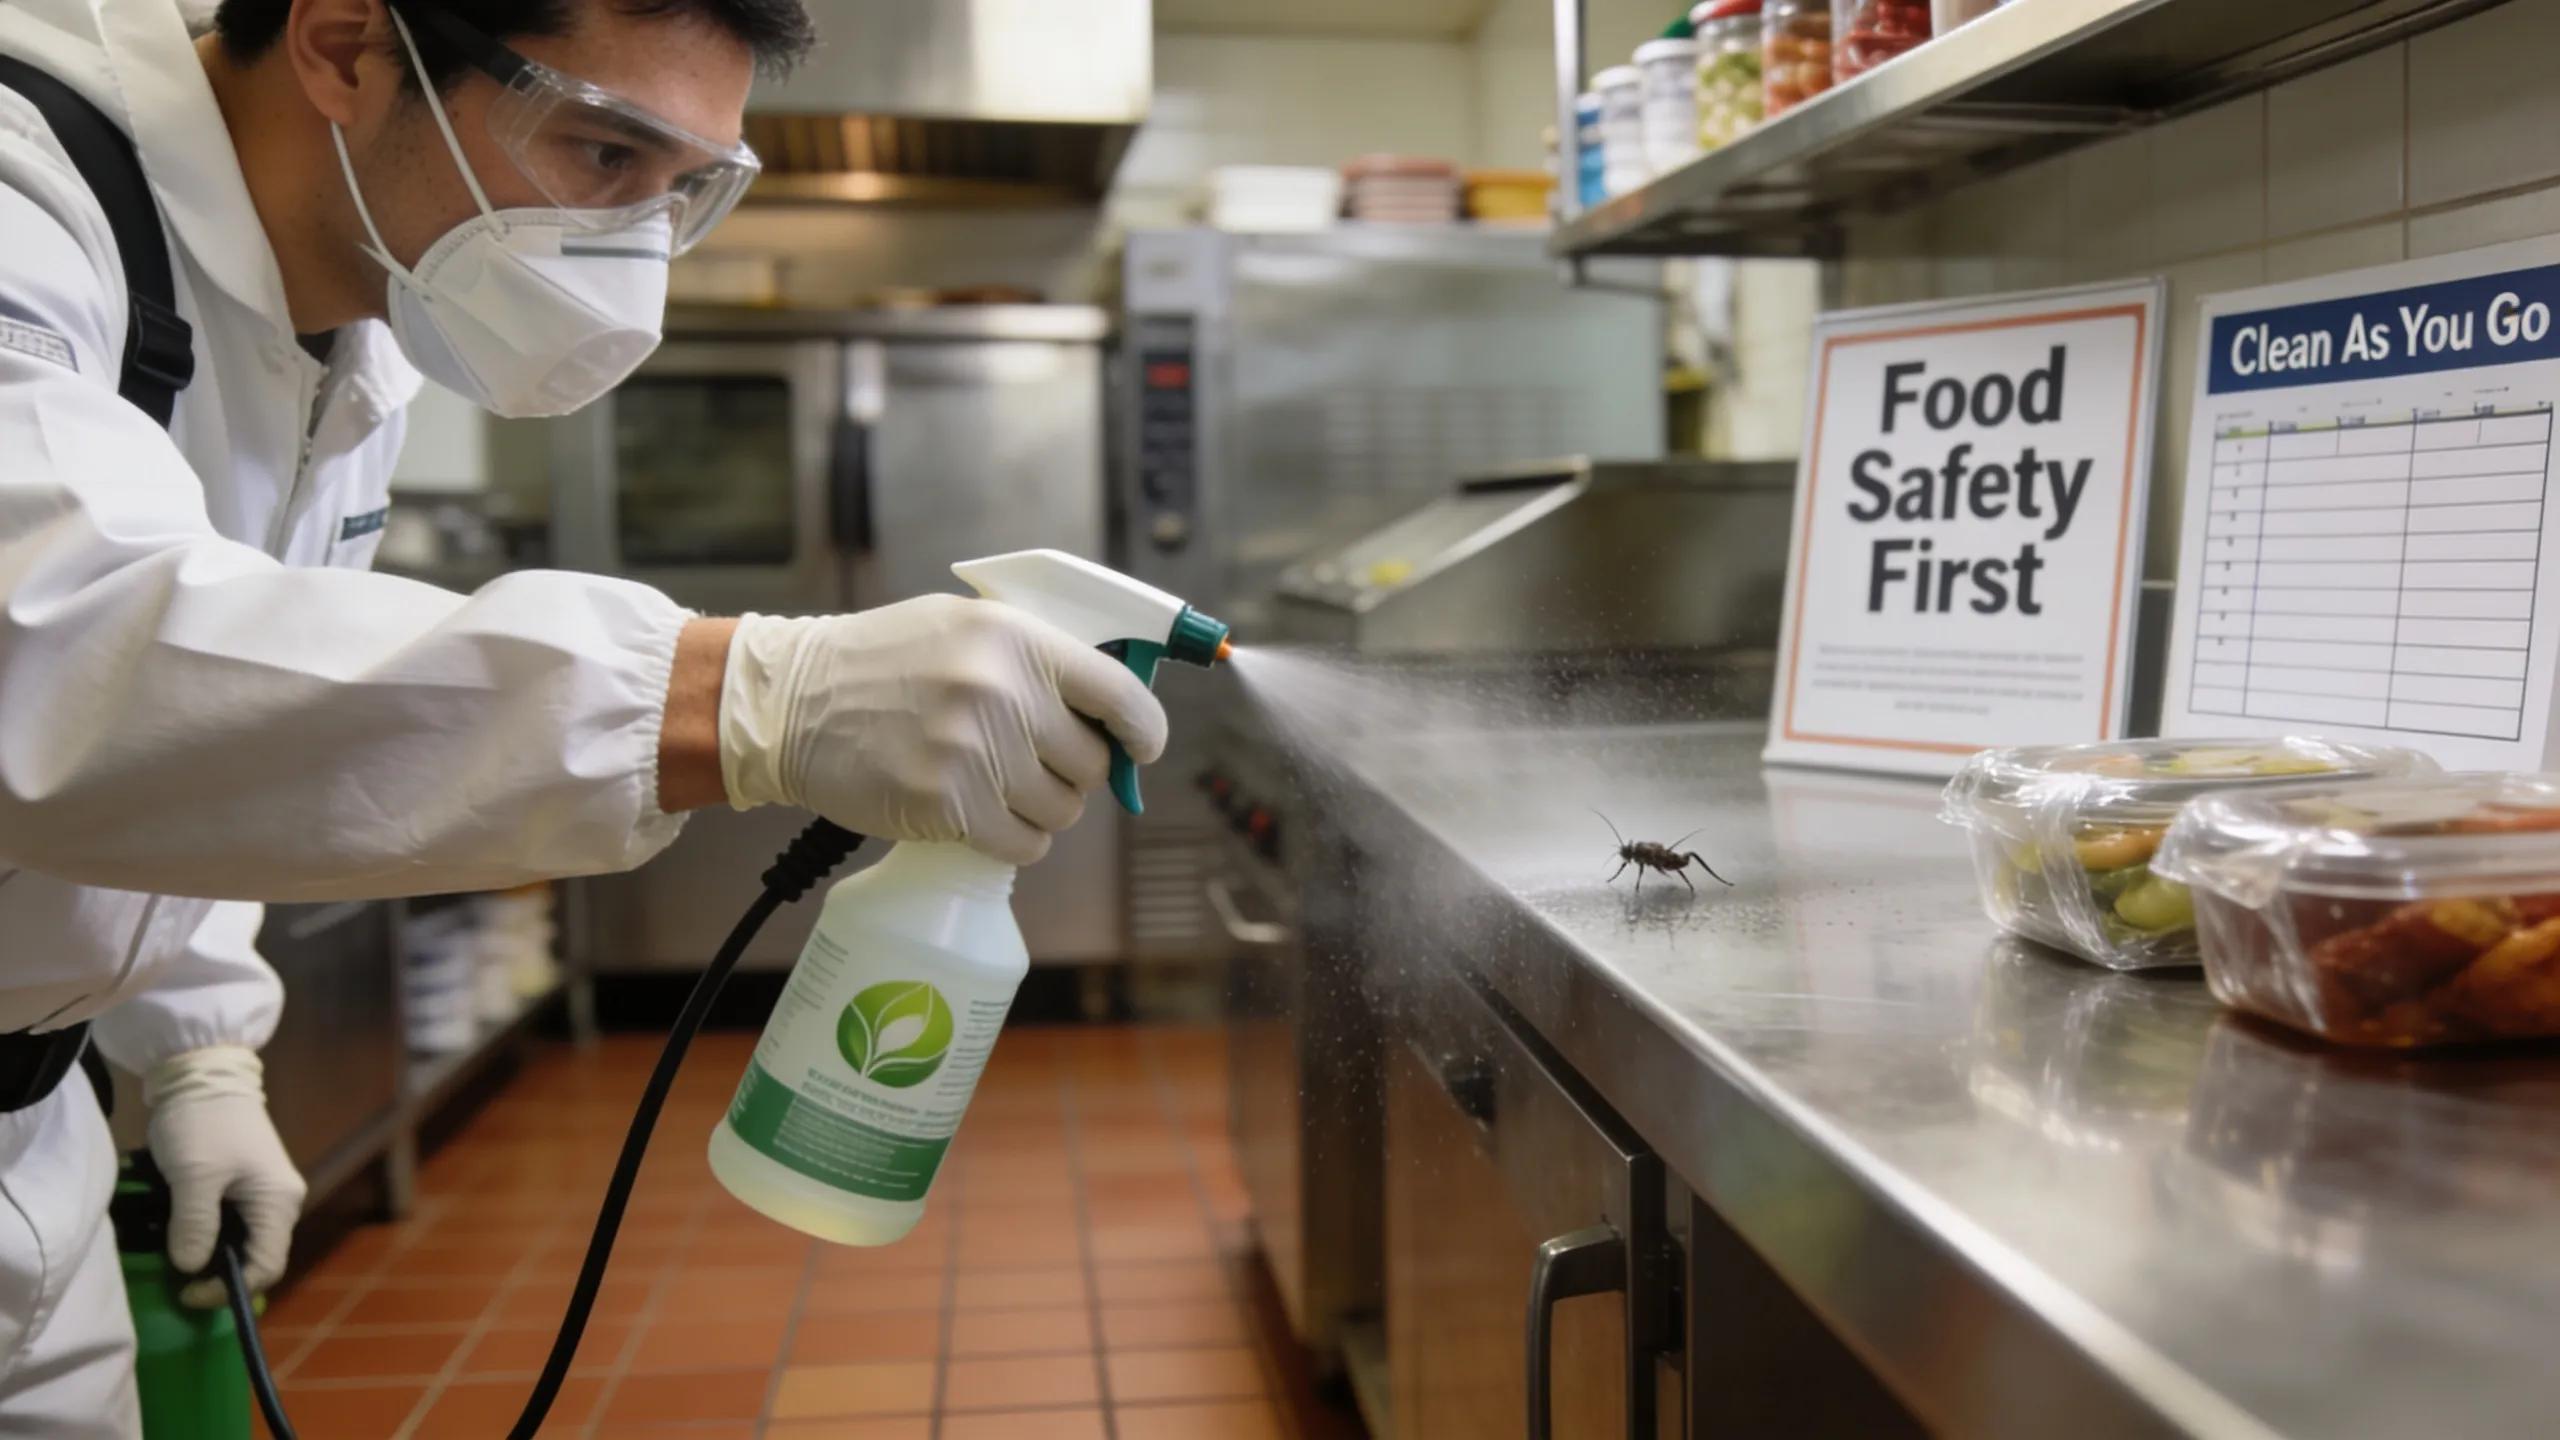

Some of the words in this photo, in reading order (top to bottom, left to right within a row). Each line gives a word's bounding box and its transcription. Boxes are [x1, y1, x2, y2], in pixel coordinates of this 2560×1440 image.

[2231, 323, 2333, 376] Clean
[2341, 312, 2391, 363] As
[2399, 303, 2475, 357] You
[2486, 292, 2551, 346] Go
[1881, 343, 2068, 434] Food
[1847, 442, 2094, 541] Safety
[1868, 537, 2044, 616] First
